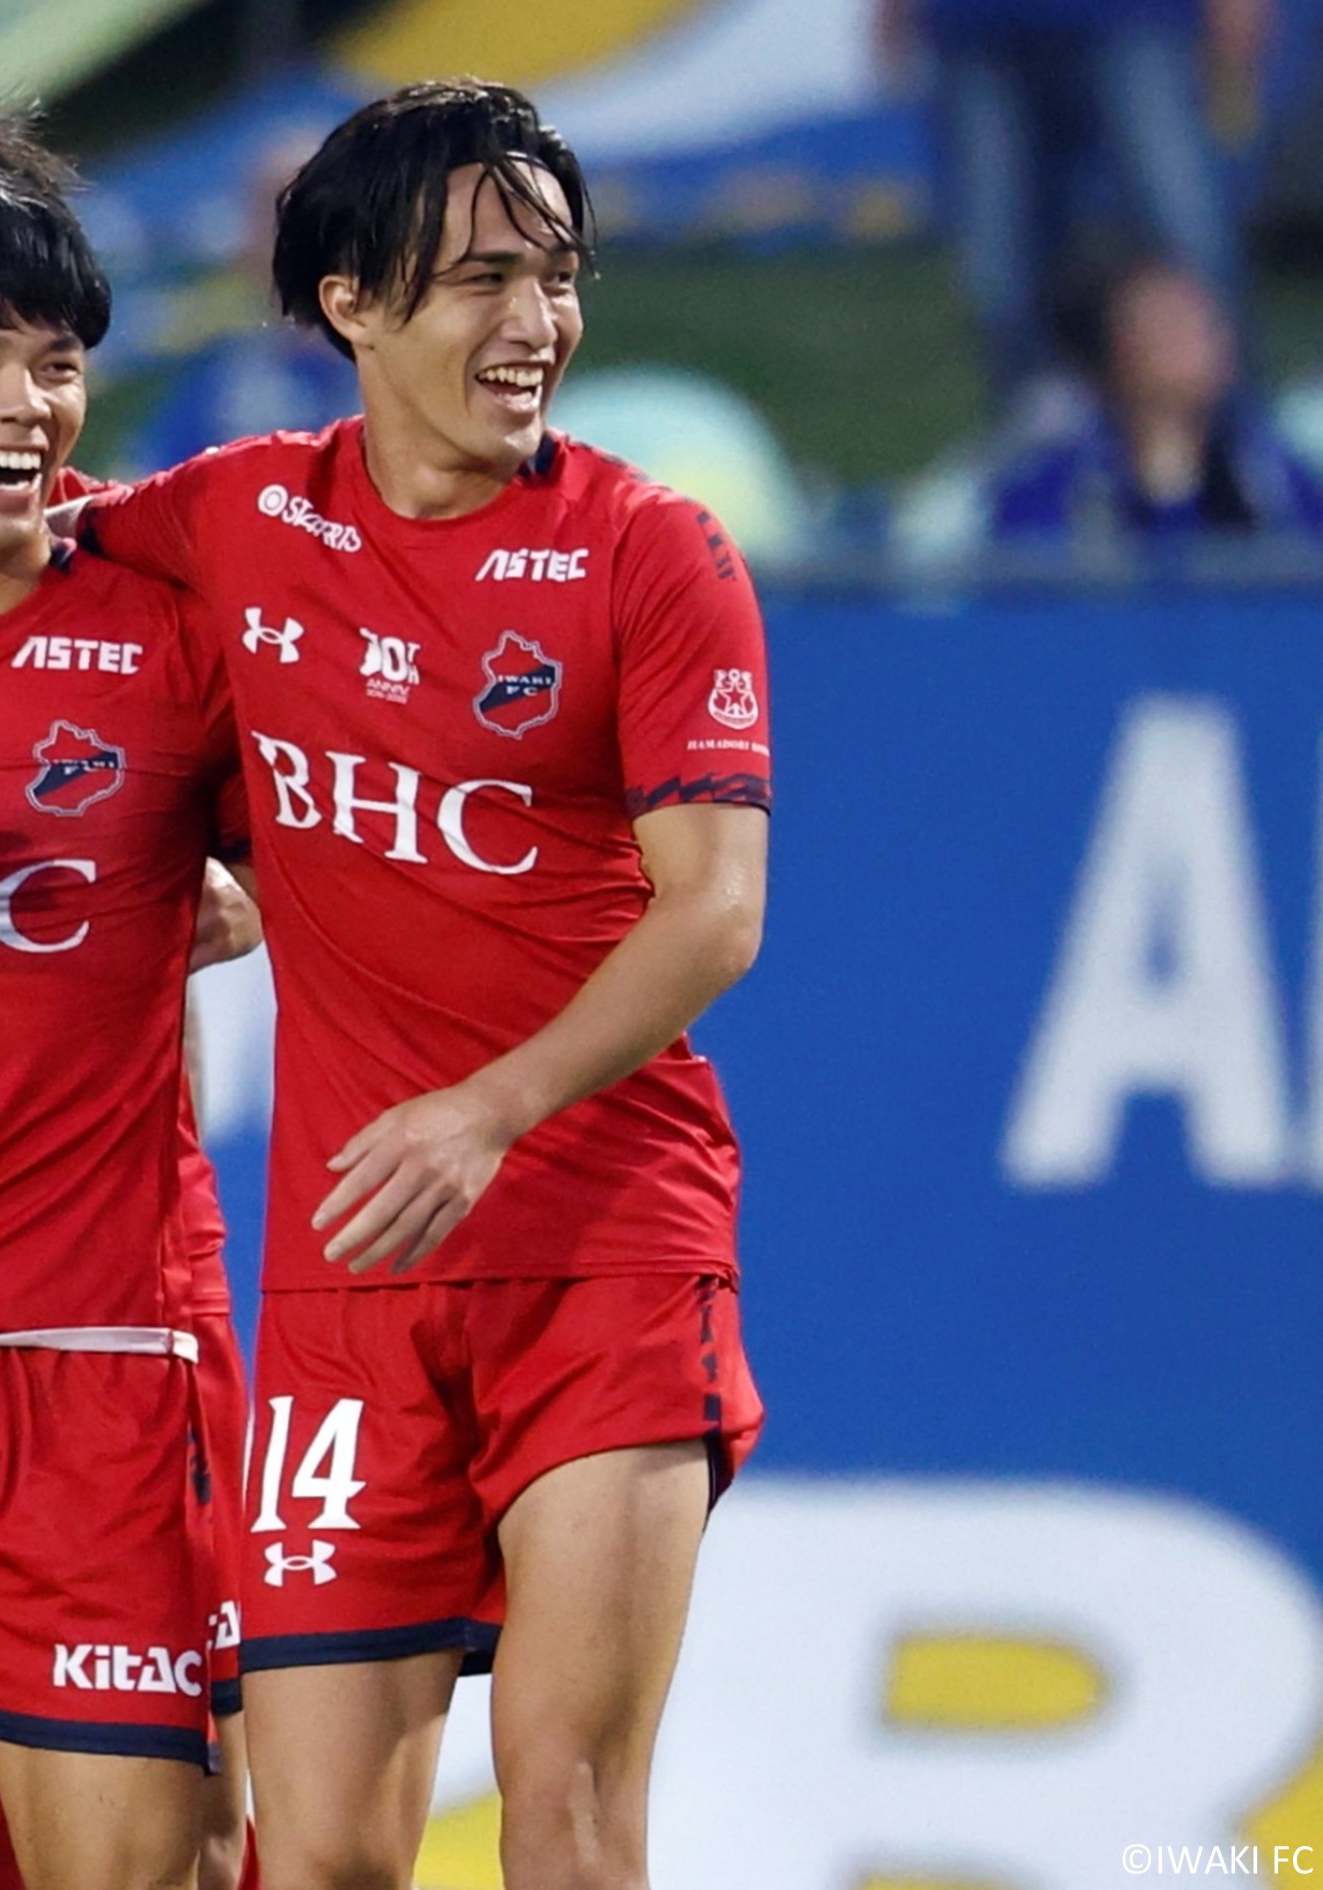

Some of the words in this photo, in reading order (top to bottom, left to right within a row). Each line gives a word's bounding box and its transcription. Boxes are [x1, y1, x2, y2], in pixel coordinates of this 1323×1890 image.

[474, 547, 589, 582] ASTEC
[11, 635, 143, 675] ASTEC
[251, 730, 539, 875] BHC
[250, 1395, 367, 1533] 14
